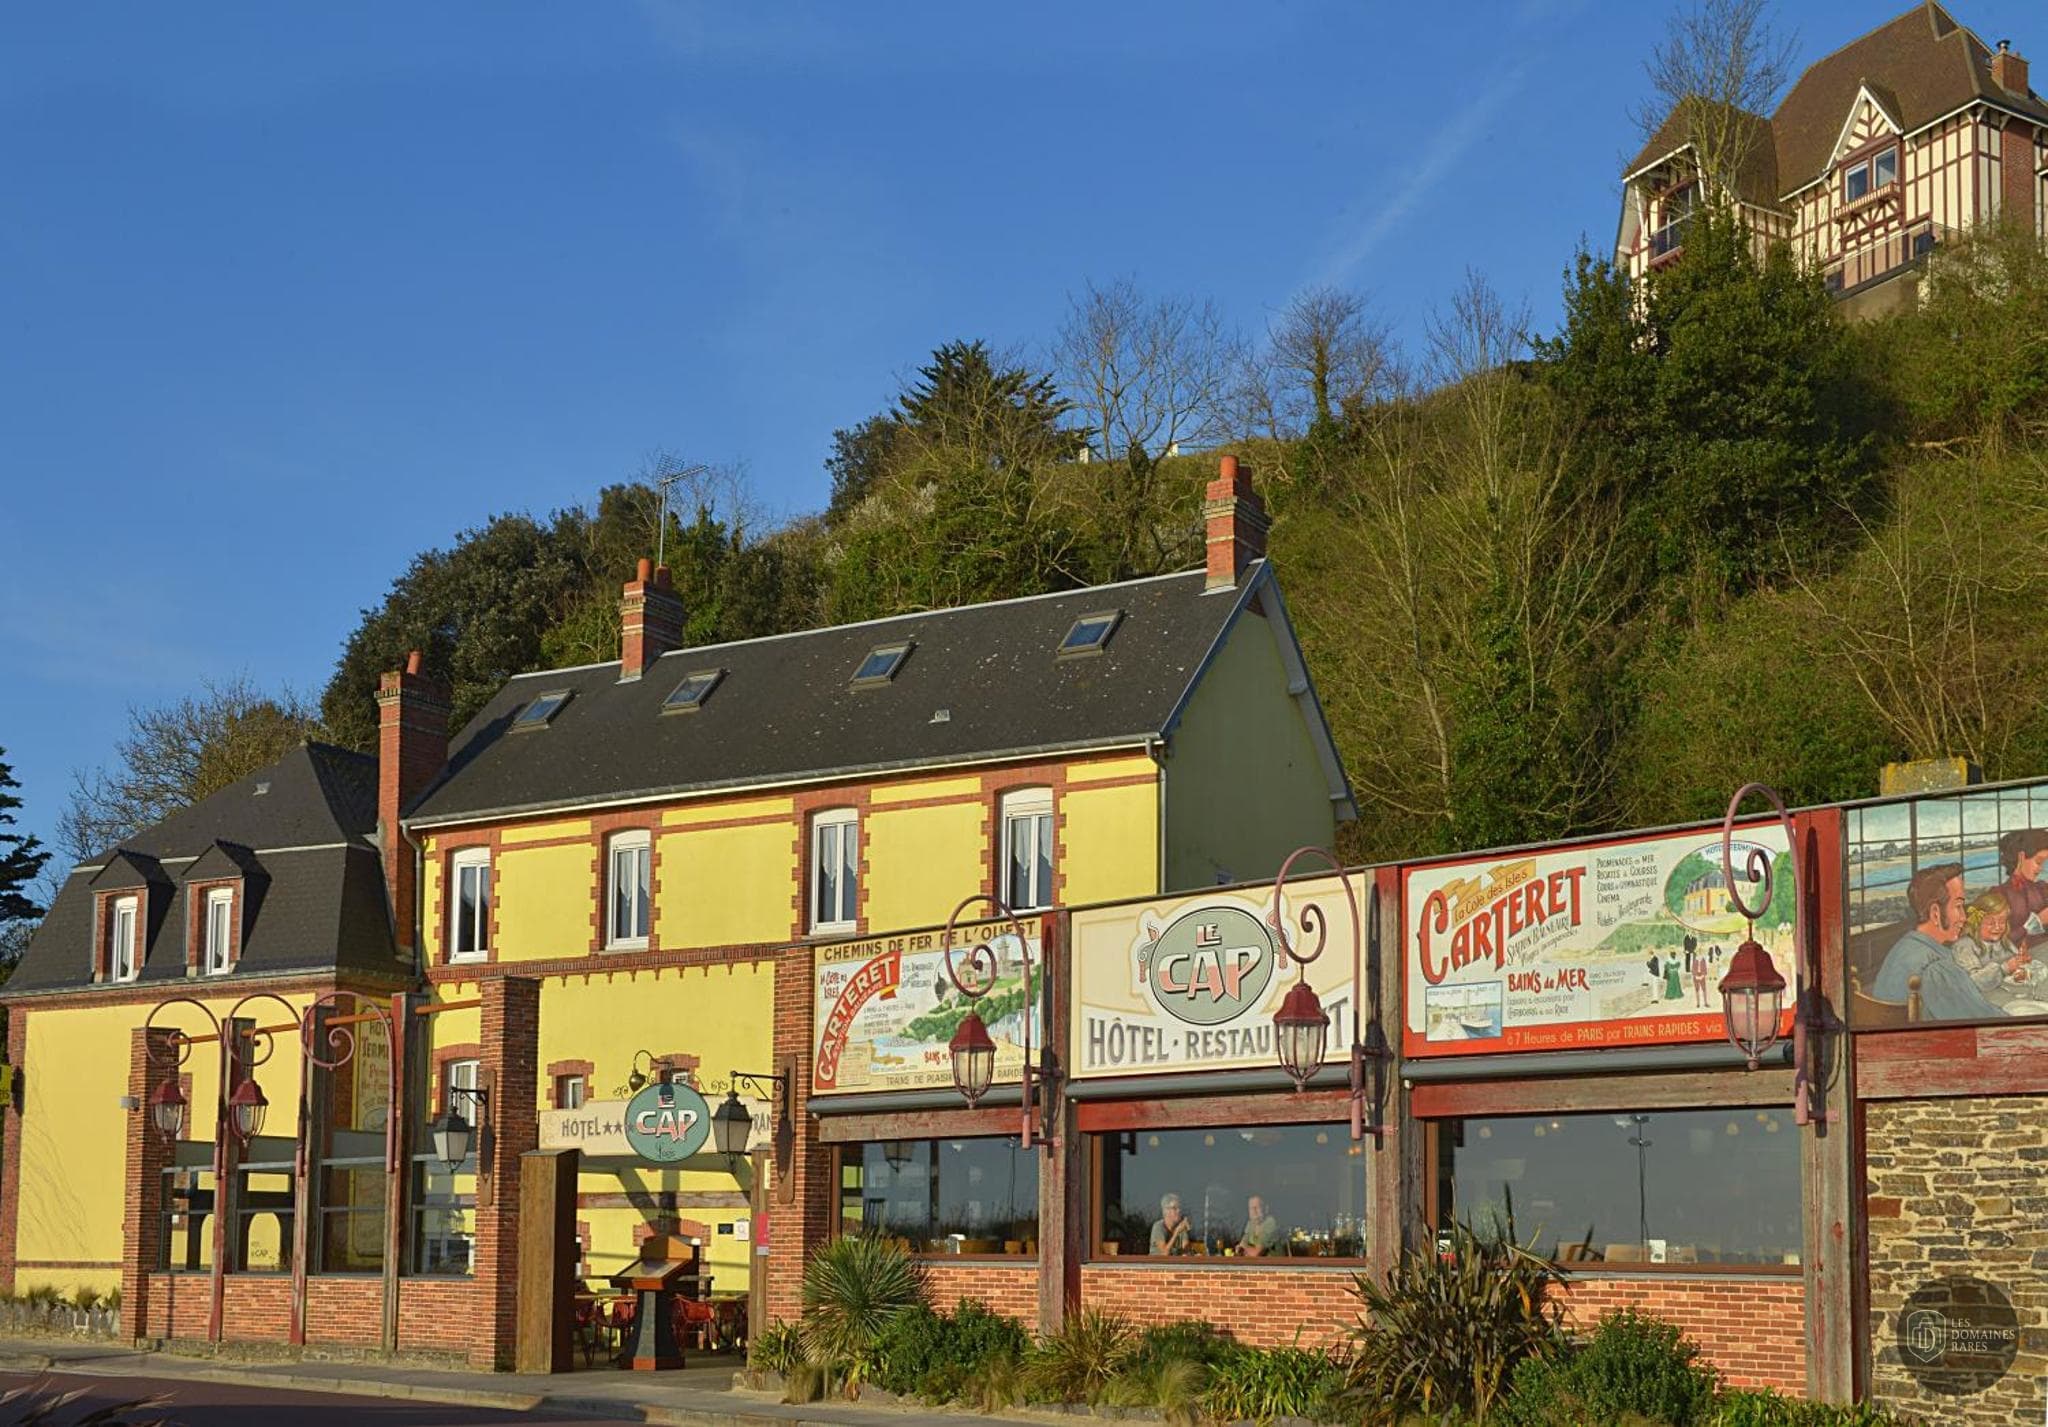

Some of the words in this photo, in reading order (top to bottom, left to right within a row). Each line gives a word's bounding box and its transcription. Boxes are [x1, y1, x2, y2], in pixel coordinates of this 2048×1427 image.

[1642, 854, 1654, 864] MER
[824, 941, 882, 961] CHEMINS
[888, 938, 904, 952] DE
[909, 934, 932, 950] FER
[1196, 923, 1221, 946] LE
[1158, 946, 1262, 1002] CAP
[1508, 969, 1541, 993] BAINS
[1556, 968, 1590, 992] MER
[818, 956, 895, 1081] CARTERET
[1088, 1016, 1169, 1067] HÔTEL
[1185, 997, 1349, 1060] RESTAUT
[1561, 1031, 1573, 1042] de
[1577, 1027, 1604, 1041] PARIS
[1623, 1023, 1655, 1038] TRAINS
[1658, 1021, 1699, 1036] RAPIDES
[636, 1109, 698, 1143] CAP
